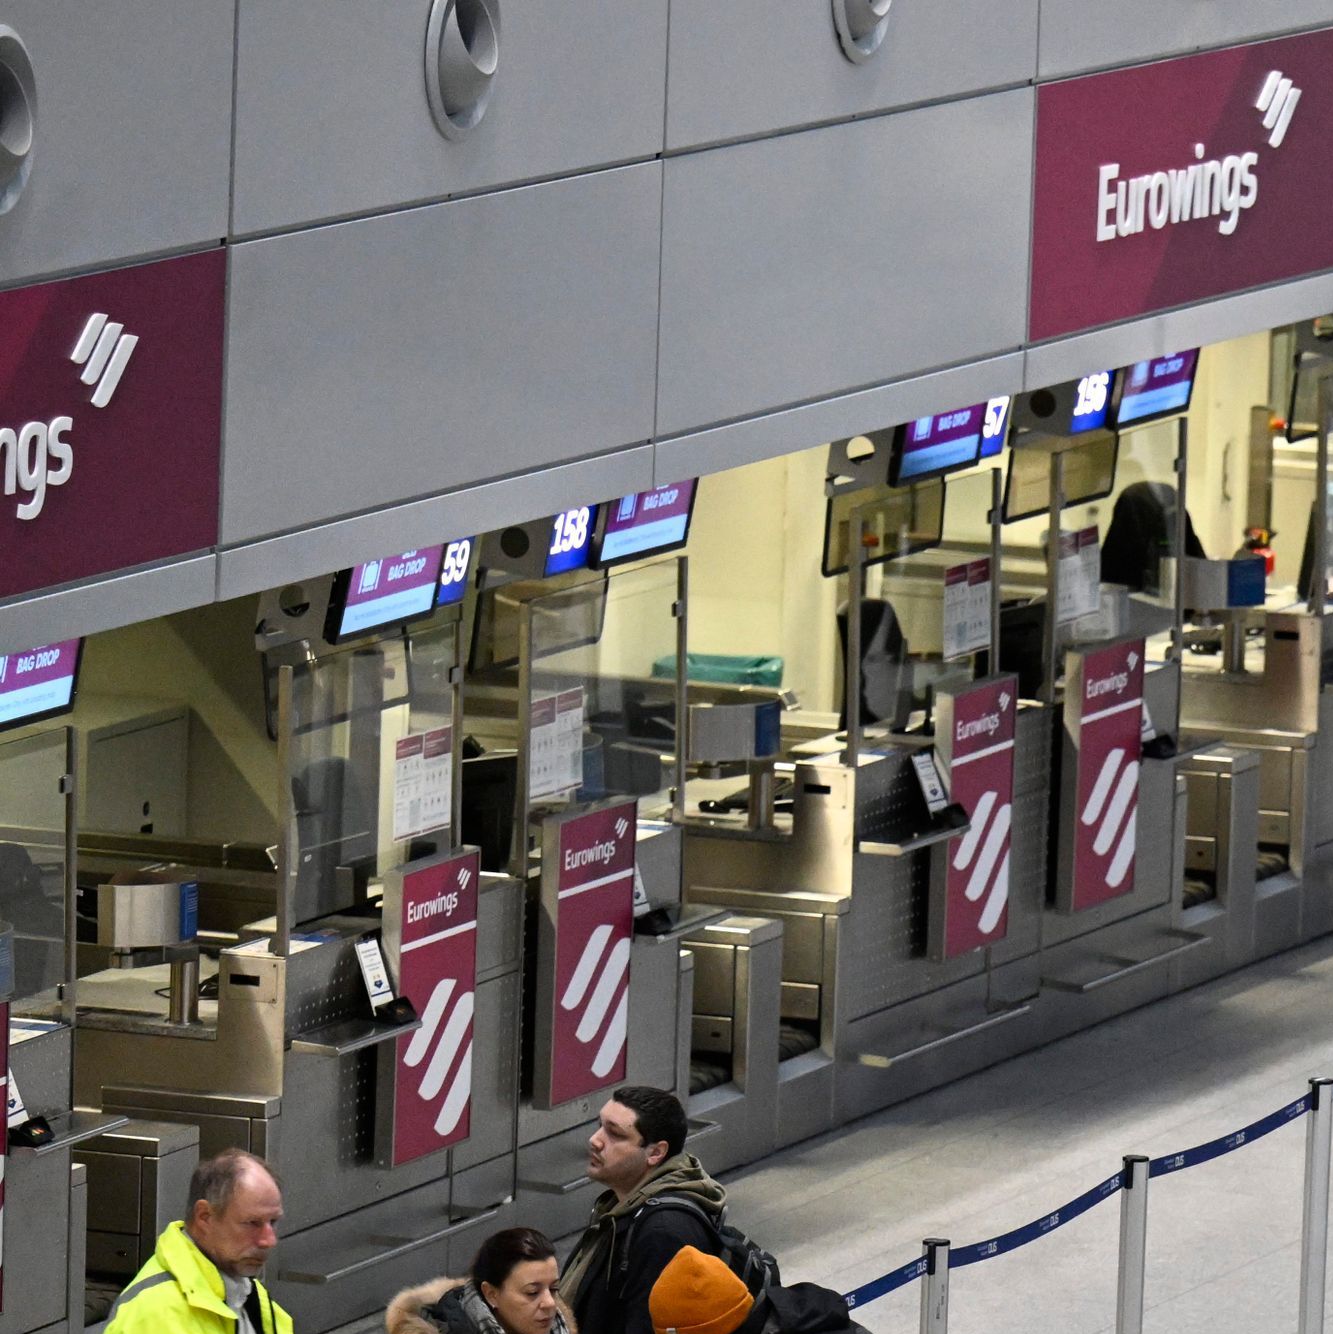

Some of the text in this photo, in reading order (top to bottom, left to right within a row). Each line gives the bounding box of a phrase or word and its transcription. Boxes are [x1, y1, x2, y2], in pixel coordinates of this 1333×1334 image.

[1097, 142, 1258, 241] Eurowings
[1073, 372, 1109, 416] 156
[982, 396, 1010, 438] 57
[644, 489, 678, 510] BAG DROP
[550, 506, 590, 555] 158
[388, 557, 427, 581] BAG DROP
[441, 539, 471, 585] 59
[16, 650, 60, 674] BAG DROP
[1086, 671, 1128, 699] Eurowings
[957, 712, 999, 741] Eurowings
[565, 840, 616, 871] Eurowings
[408, 891, 458, 924] Eurowings
